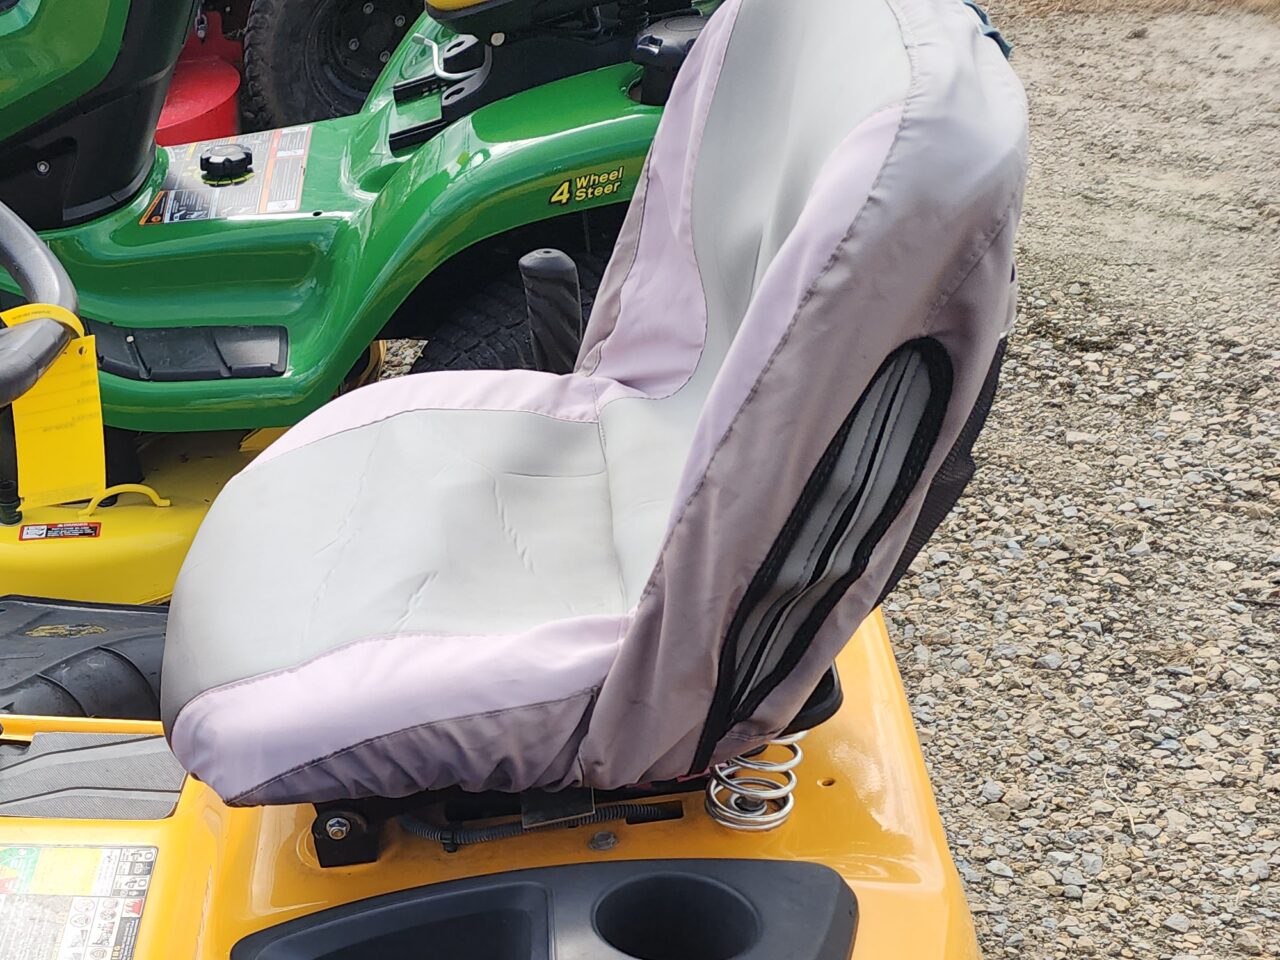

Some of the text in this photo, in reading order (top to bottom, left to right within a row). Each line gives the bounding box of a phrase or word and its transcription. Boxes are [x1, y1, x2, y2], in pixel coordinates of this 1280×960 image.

[549, 166, 624, 205] 4 Wheel
[574, 181, 621, 201] Steer
